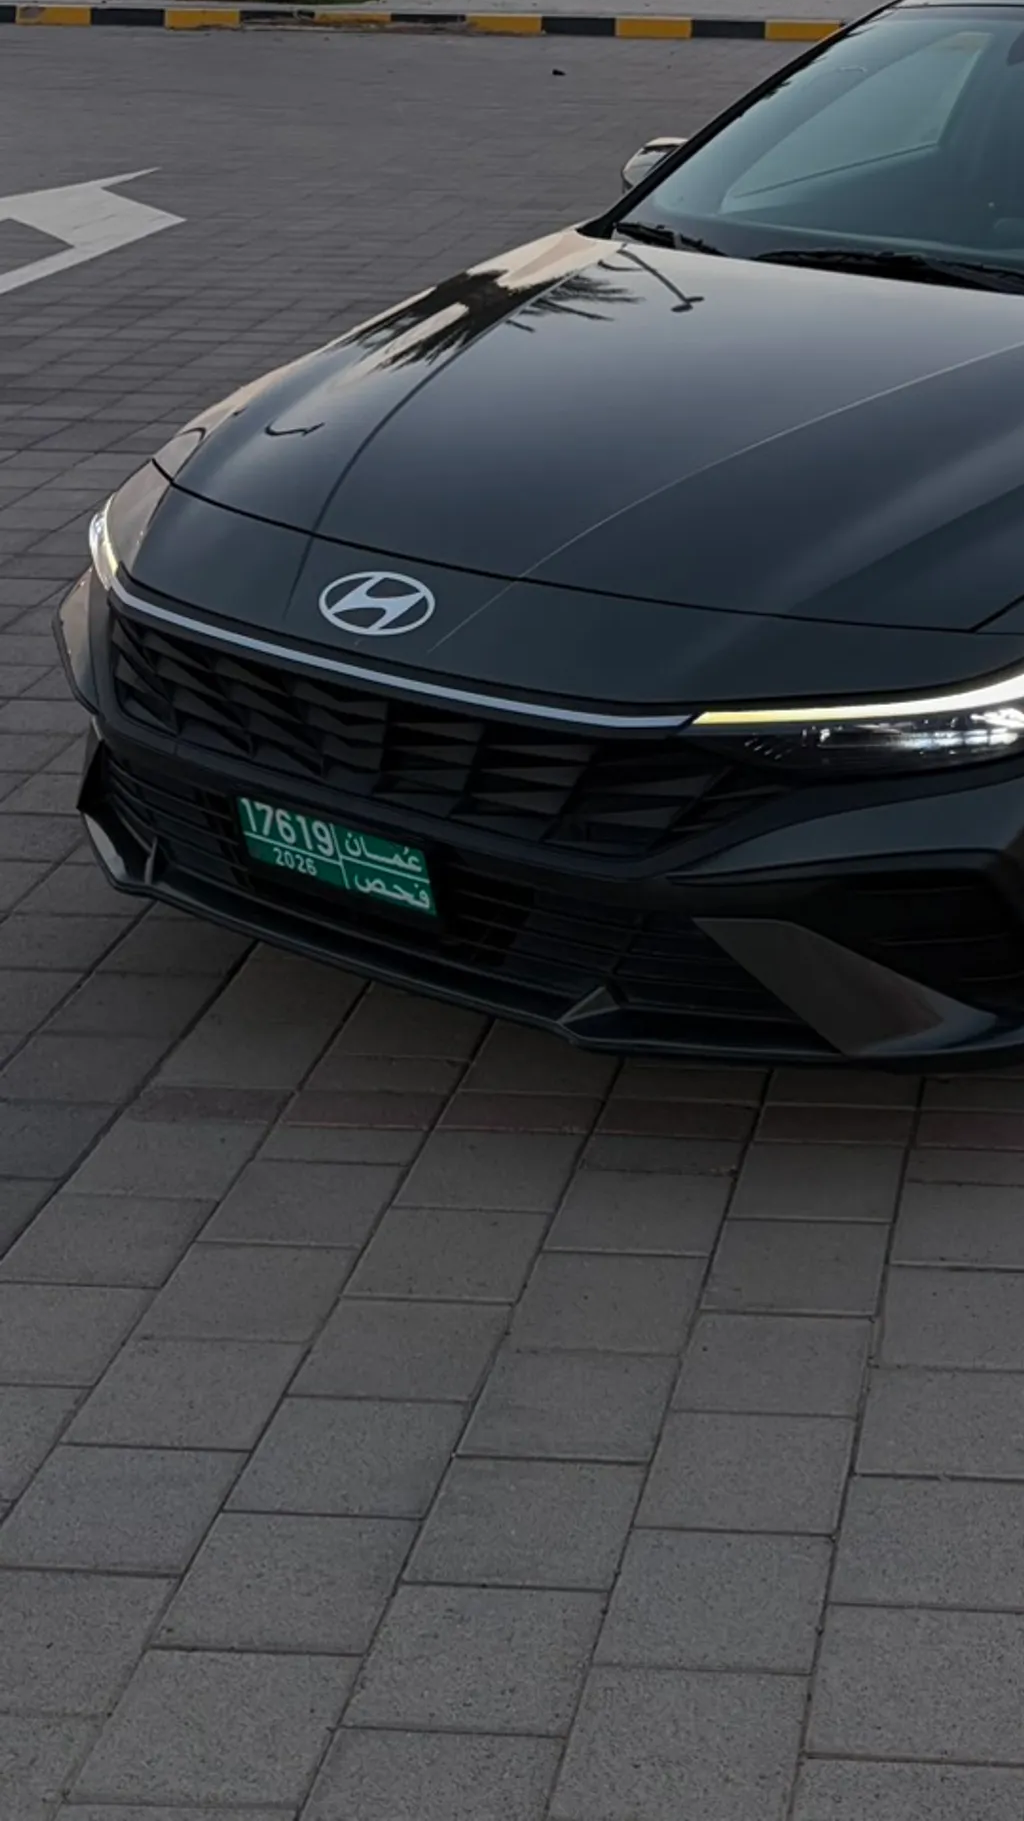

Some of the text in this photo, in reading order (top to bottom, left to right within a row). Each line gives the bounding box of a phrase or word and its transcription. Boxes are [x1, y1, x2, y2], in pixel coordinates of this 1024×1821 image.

[239, 797, 335, 857] 17619
[273, 847, 318, 877] 2026
[354, 874, 431, 910] فحص
